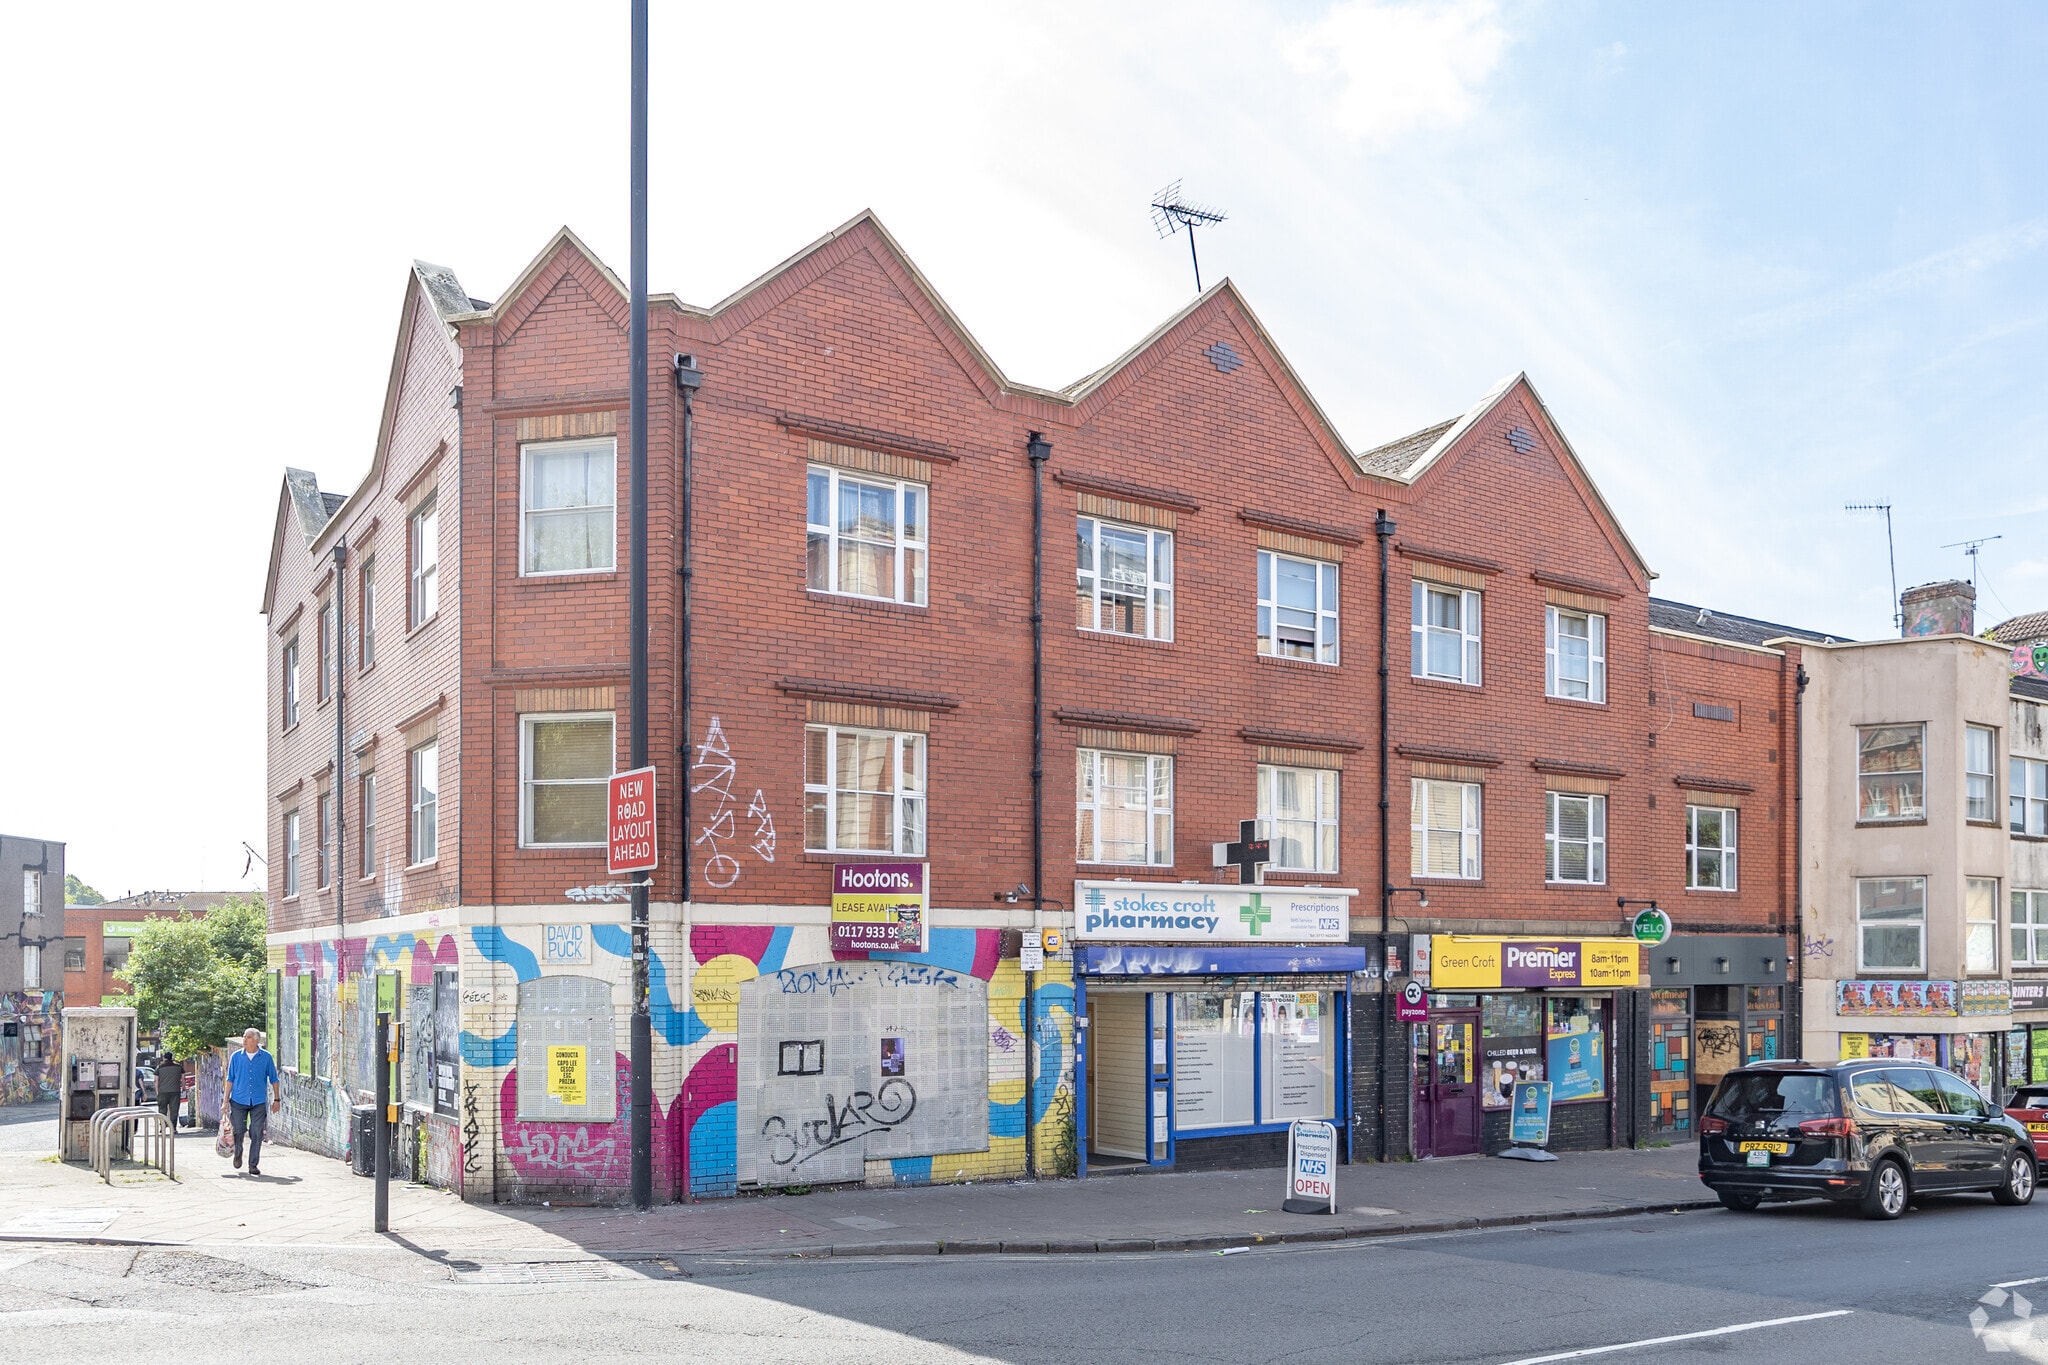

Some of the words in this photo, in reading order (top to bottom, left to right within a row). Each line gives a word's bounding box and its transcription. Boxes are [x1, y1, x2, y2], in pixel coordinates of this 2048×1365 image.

[620, 780, 643, 799] NEW
[617, 801, 646, 820] ROAD
[612, 820, 651, 842] LAYOUT
[614, 841, 650, 862] AHEAD
[836, 902, 865, 912] LEASE
[1113, 893, 1168, 911] stokes
[1173, 894, 1215, 912] croft
[1291, 902, 1339, 913] Prescriptions
[1086, 908, 1219, 933] pharmacy
[1319, 918, 1339, 930] NHS
[547, 925, 583, 941] DAVID
[838, 926, 864, 937] 0117
[866, 926, 885, 938] 933
[888, 927, 899, 938] 99
[1635, 923, 1664, 933] VELO
[548, 941, 582, 958] PUCK
[851, 940, 899, 949] hootons.co.uk
[1441, 956, 1469, 968] Green
[1472, 955, 1495, 968] Croft
[1507, 946, 1576, 968] Premier
[1591, 953, 1629, 965] 8am-11pm
[1549, 968, 1576, 981] Express
[1590, 968, 1631, 979] 10am-11pm
[2012, 986, 2044, 997] RINTERS
[1401, 1009, 1426, 1017] payzone
[1487, 1049, 1506, 1057] CHILLED
[1296, 1132, 1330, 1140] pharmacy
[1297, 1143, 1330, 1152] Prescriptions
[1745, 1143, 1761, 1151] PRZ
[1300, 1150, 1327, 1159] Dispensed
[1301, 1159, 1325, 1174] NHS
[1296, 1179, 1330, 1195] OPEN
